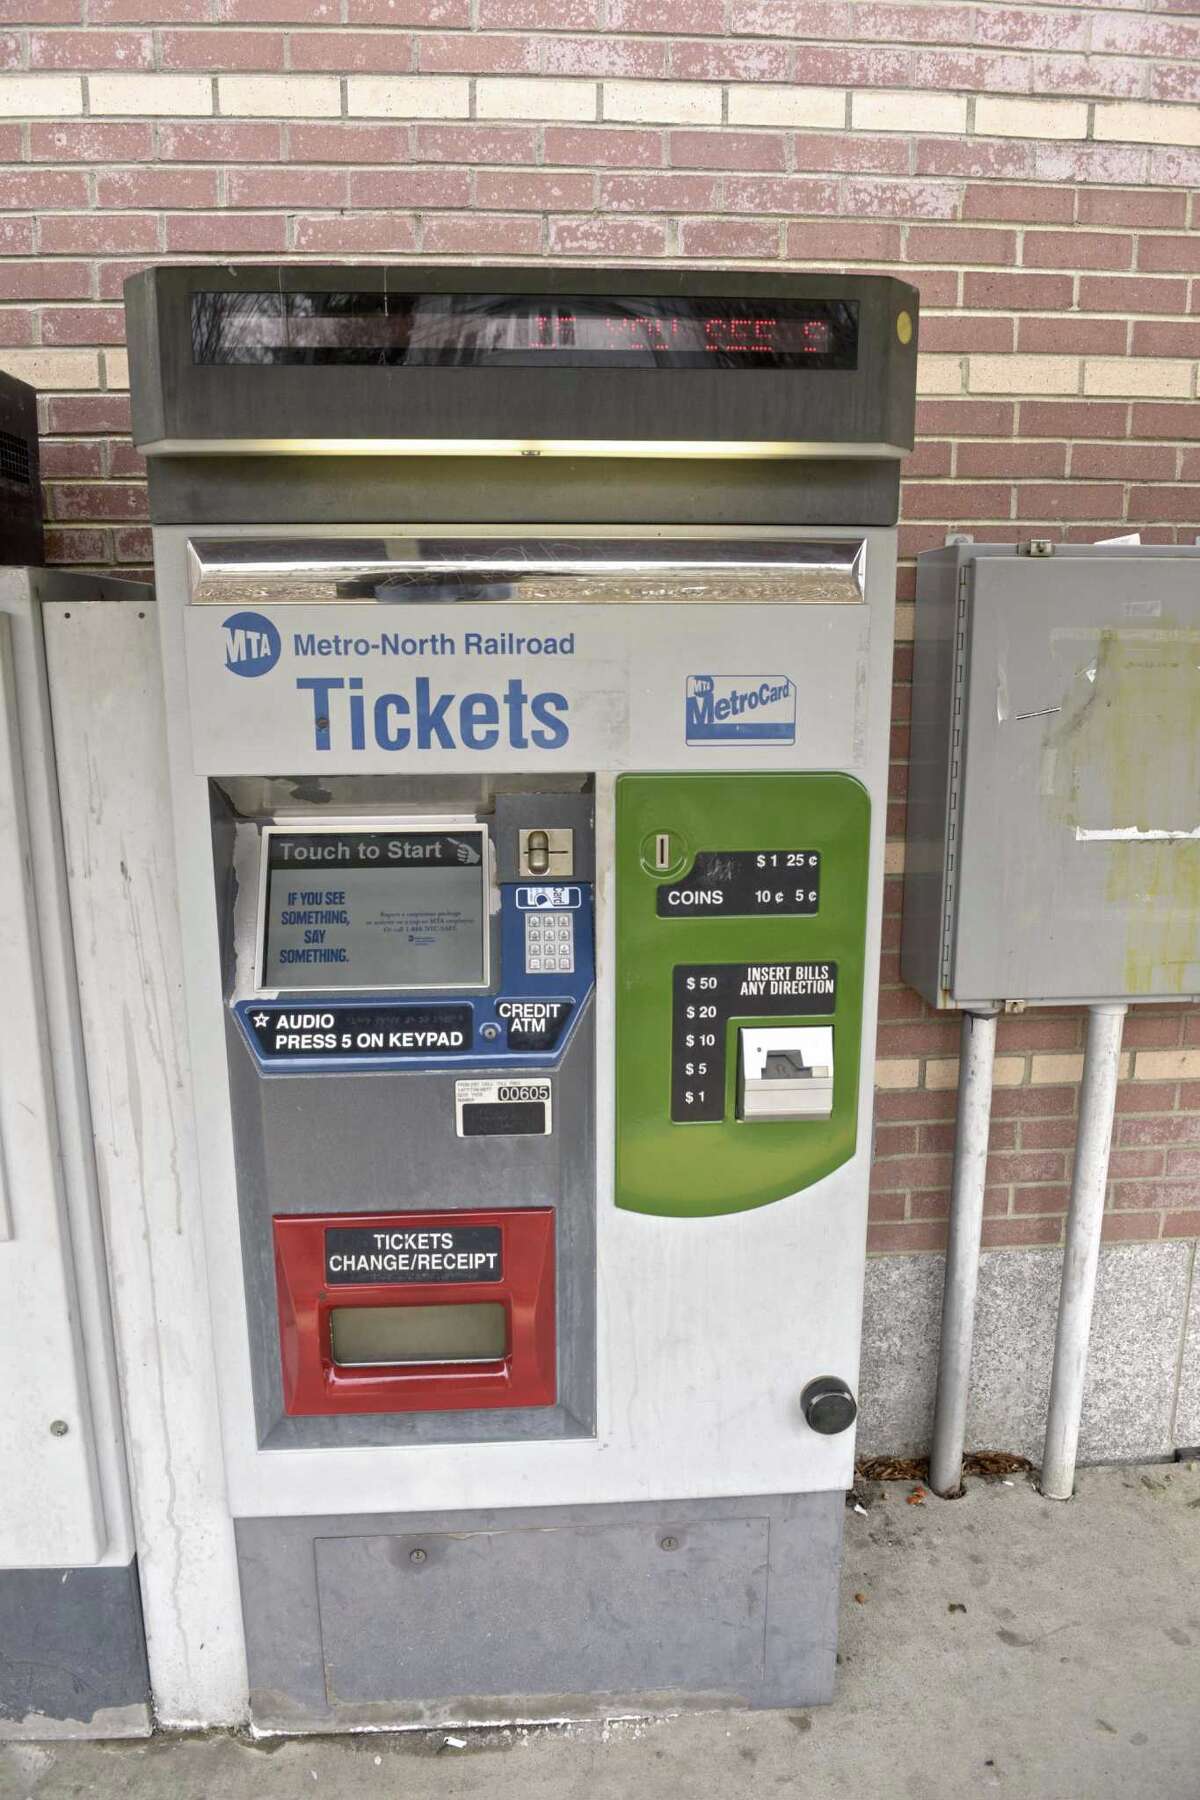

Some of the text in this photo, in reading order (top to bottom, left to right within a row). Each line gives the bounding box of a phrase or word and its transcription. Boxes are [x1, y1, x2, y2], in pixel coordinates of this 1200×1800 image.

[222, 626, 272, 664] MTA
[294, 632, 575, 656] Metro-North Railroad
[686, 680, 789, 724] MetroCard
[296, 676, 569, 751] Tickets
[279, 840, 442, 860] Touch to Start
[287, 891, 346, 906] IF YOU SEE
[668, 890, 724, 905] COINS
[281, 910, 350, 927] SOMETHING,
[304, 930, 326, 944] SAY
[279, 949, 349, 964] SOMETHING.
[747, 965, 829, 981] INSERT BILLS
[740, 979, 834, 996] ANY DIRECTION
[499, 1002, 561, 1019] CREDIT
[276, 1013, 335, 1030] AUDIO
[510, 1018, 546, 1033] ATM
[275, 1031, 464, 1050] PRESS 5 ON KEYPAD
[500, 1086, 549, 1101] 00605
[373, 1233, 453, 1251] TICKETS
[329, 1252, 498, 1272] CHANGE/RECEIPT
